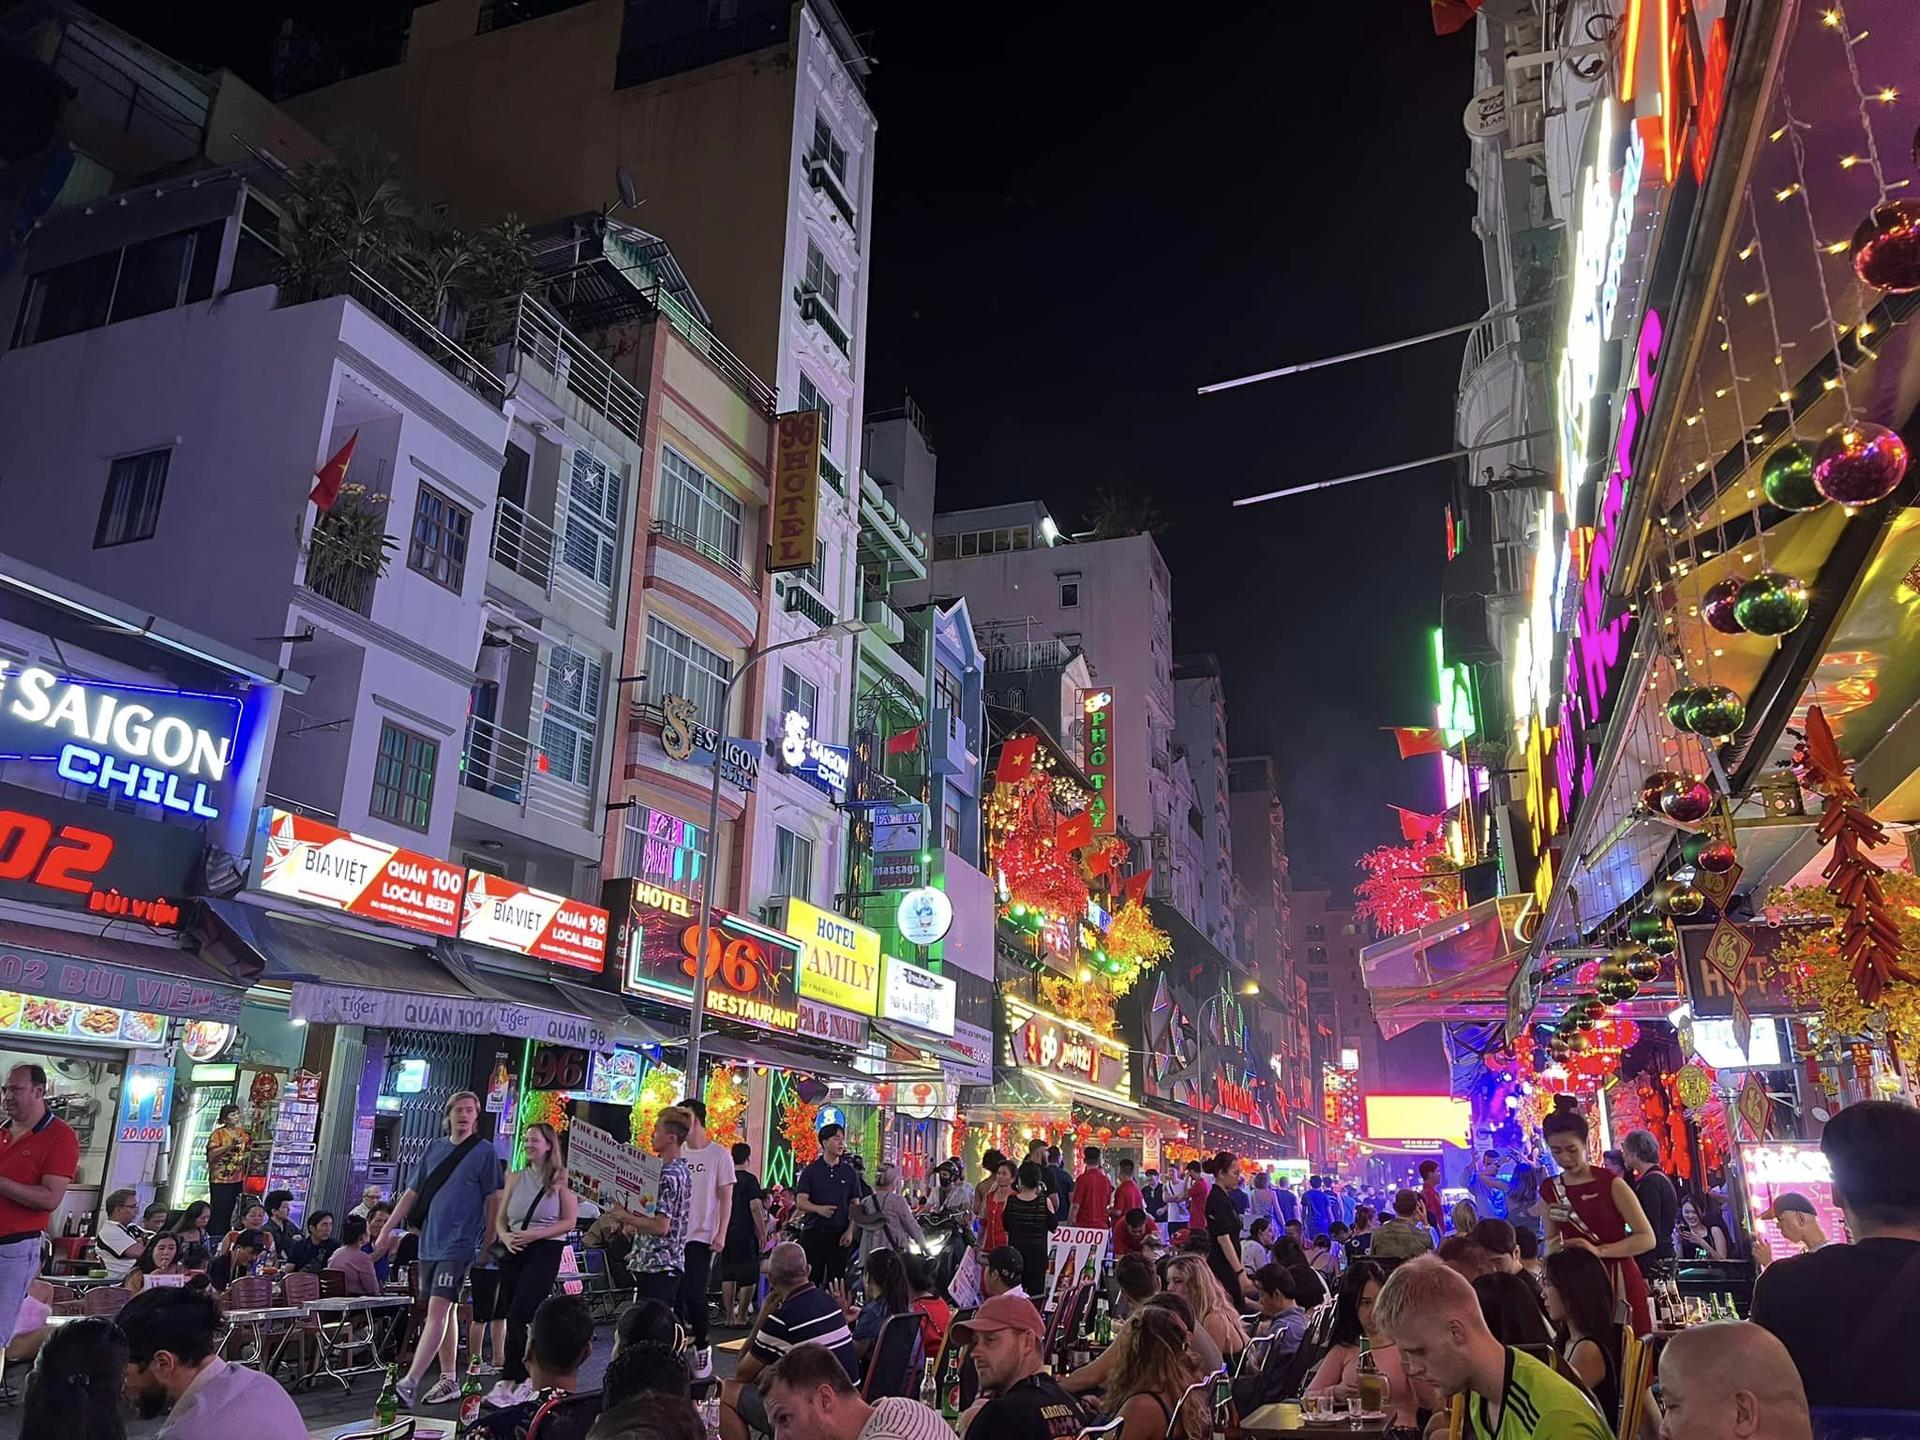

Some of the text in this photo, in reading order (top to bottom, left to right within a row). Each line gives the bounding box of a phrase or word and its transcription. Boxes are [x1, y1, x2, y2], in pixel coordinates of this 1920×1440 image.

[780, 415, 815, 449] 96
[778, 450, 810, 561] HOTEL
[13, 666, 231, 781] SAIGON
[704, 731, 759, 778] SIGON
[57, 743, 219, 819] CHILL
[305, 849, 330, 876] BIA
[388, 860, 462, 895] QUÁN 100
[90, 888, 128, 915] BÙI
[382, 882, 424, 907] LOCAL
[425, 894, 456, 915] BEER
[494, 902, 513, 924] BIA
[636, 882, 692, 918] HOTEL
[552, 927, 603, 951] LOCAL BEER
[556, 909, 588, 931] QUÁN
[589, 914, 606, 935] 98
[816, 917, 857, 950] HOTEL
[681, 924, 760, 992] 96
[800, 941, 876, 992] AMILY
[59, 963, 126, 1002] BÙI
[404, 1002, 452, 1029] QUÁN
[458, 1008, 484, 1028] 100
[547, 1018, 587, 1044] QUÁN
[588, 1026, 606, 1046] 98
[706, 988, 799, 1030] RESTAURANT
[830, 1014, 863, 1044] NAIL
[121, 1127, 164, 1140] 20.000
[1052, 1228, 1103, 1245] 20.000
